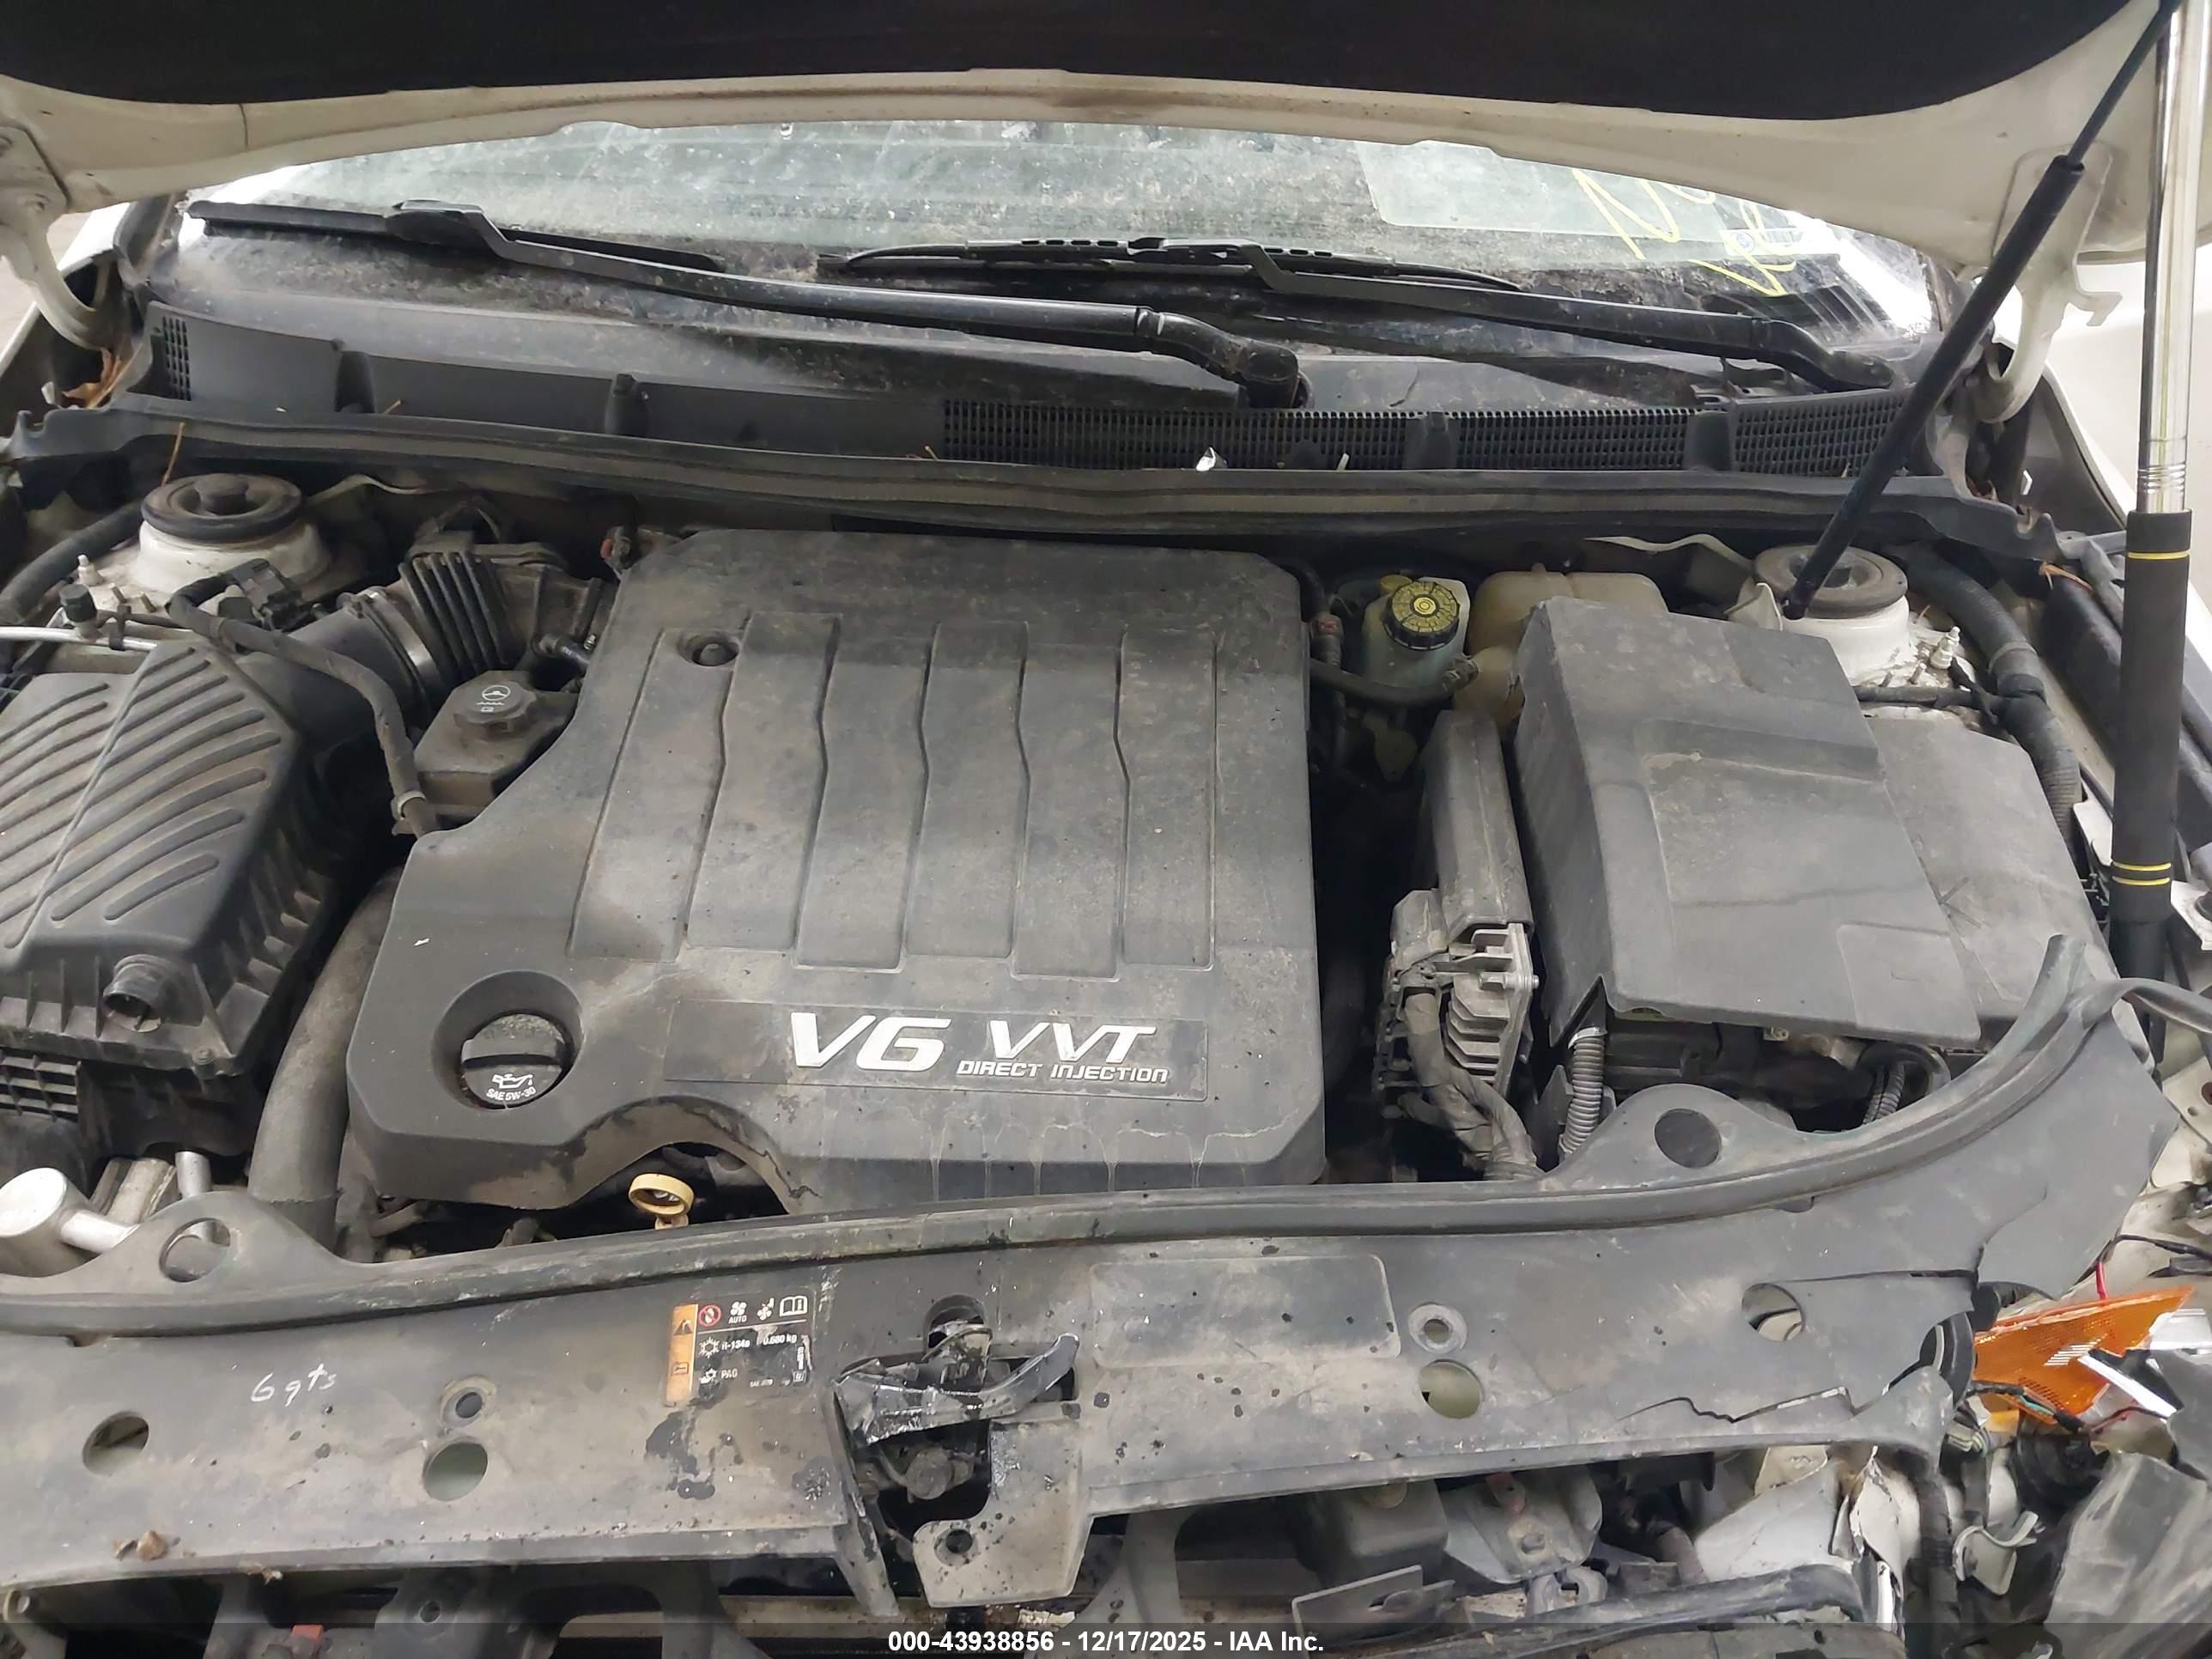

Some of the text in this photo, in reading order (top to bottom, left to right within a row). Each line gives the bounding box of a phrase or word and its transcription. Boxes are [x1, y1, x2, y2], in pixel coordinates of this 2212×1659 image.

[790, 1011, 1157, 1073] V6 VVT
[956, 1060, 1168, 1085] DIRECT INJECTION
[486, 1088, 505, 1101] SAE
[727, 1315, 747, 1324] AUTO
[785, 1333, 798, 1345] kg
